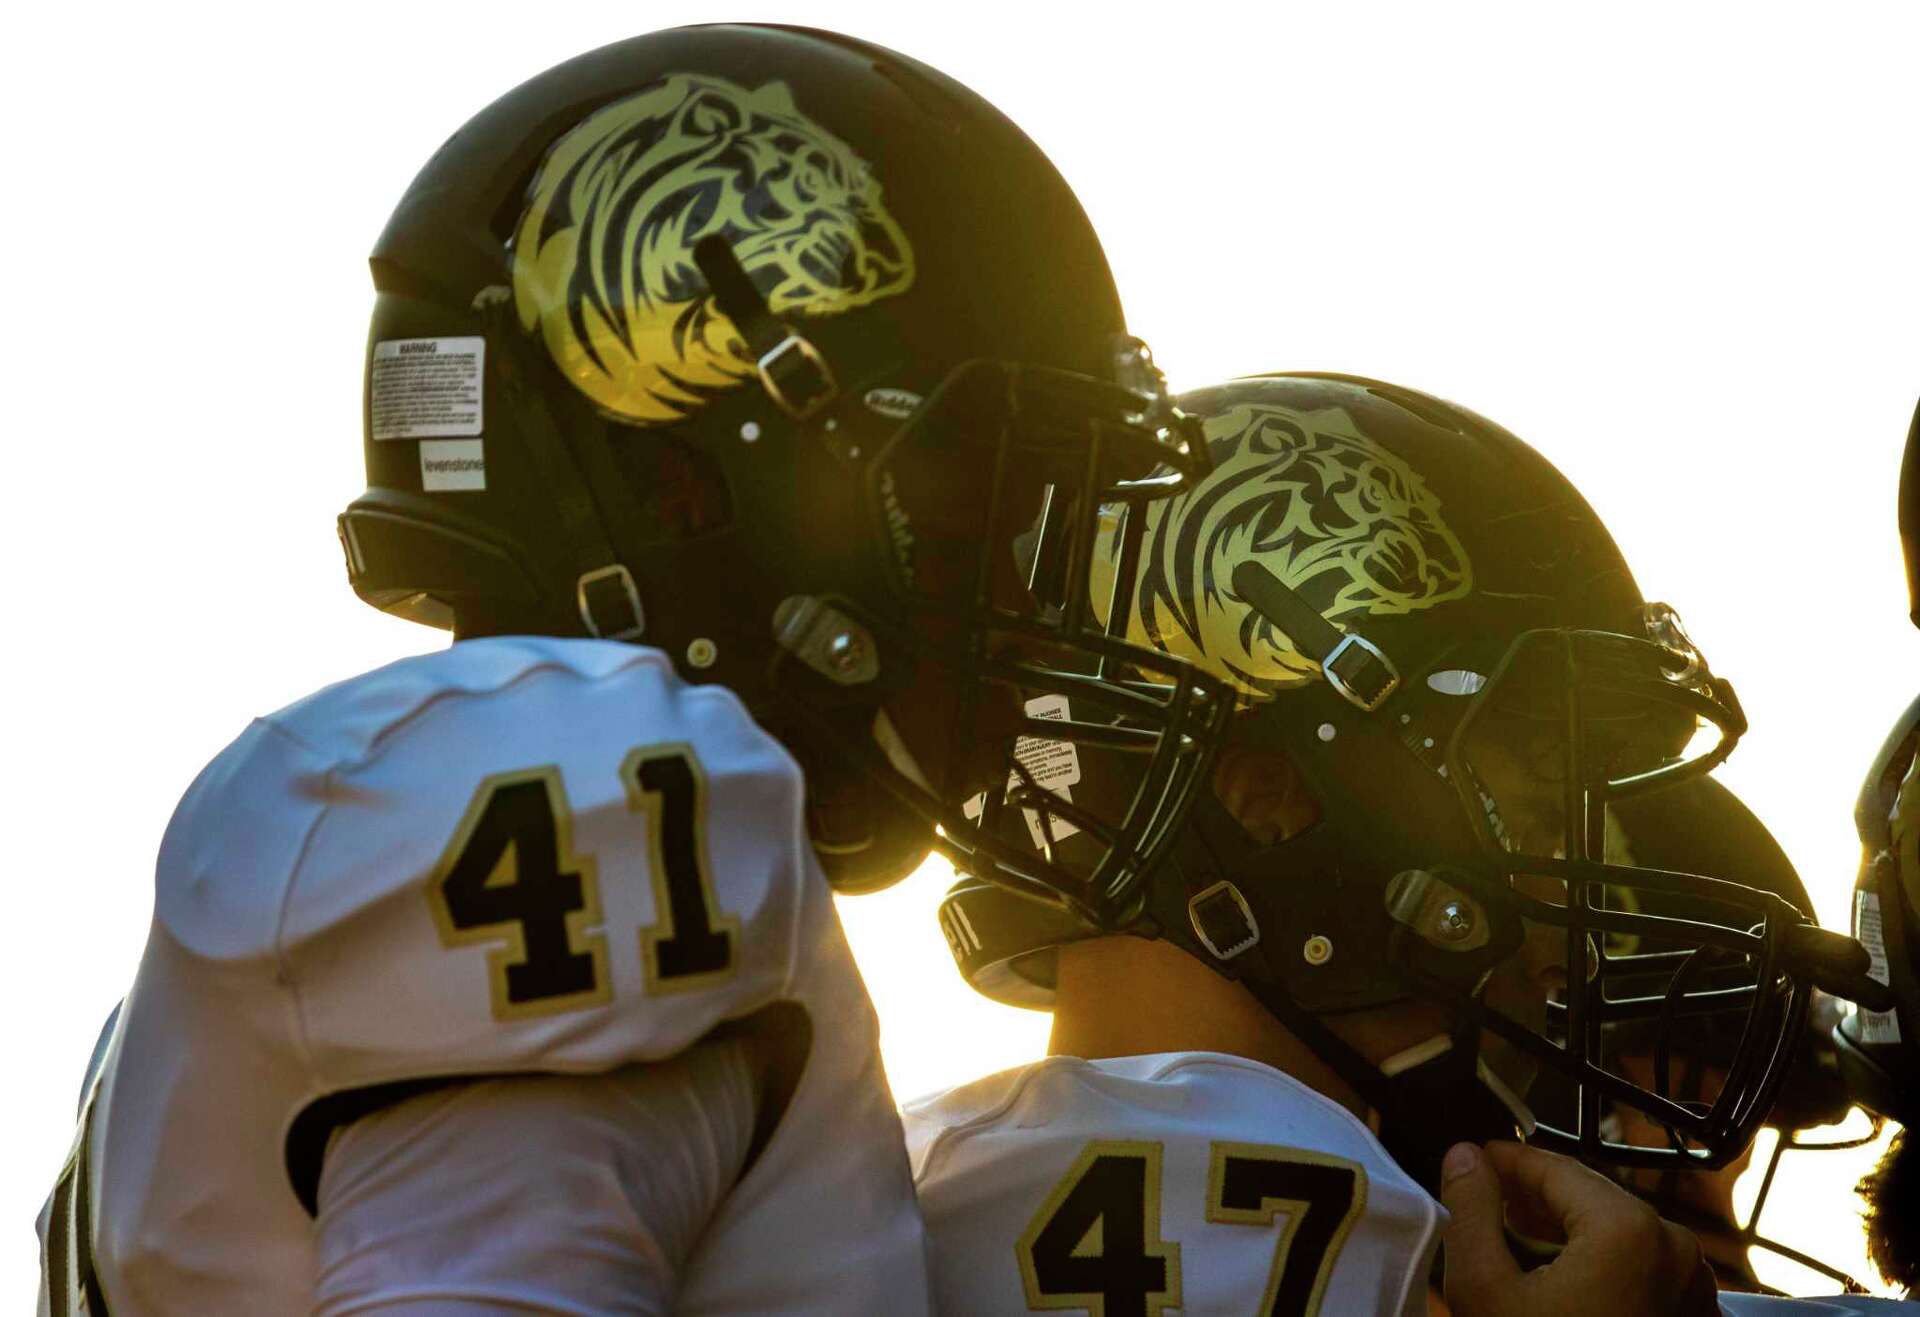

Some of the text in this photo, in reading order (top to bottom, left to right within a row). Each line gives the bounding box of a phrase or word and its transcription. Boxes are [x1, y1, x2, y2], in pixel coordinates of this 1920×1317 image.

[399, 342, 437, 354] WARNING
[426, 742, 741, 1023] 41
[1013, 1140, 1369, 1317] 47
